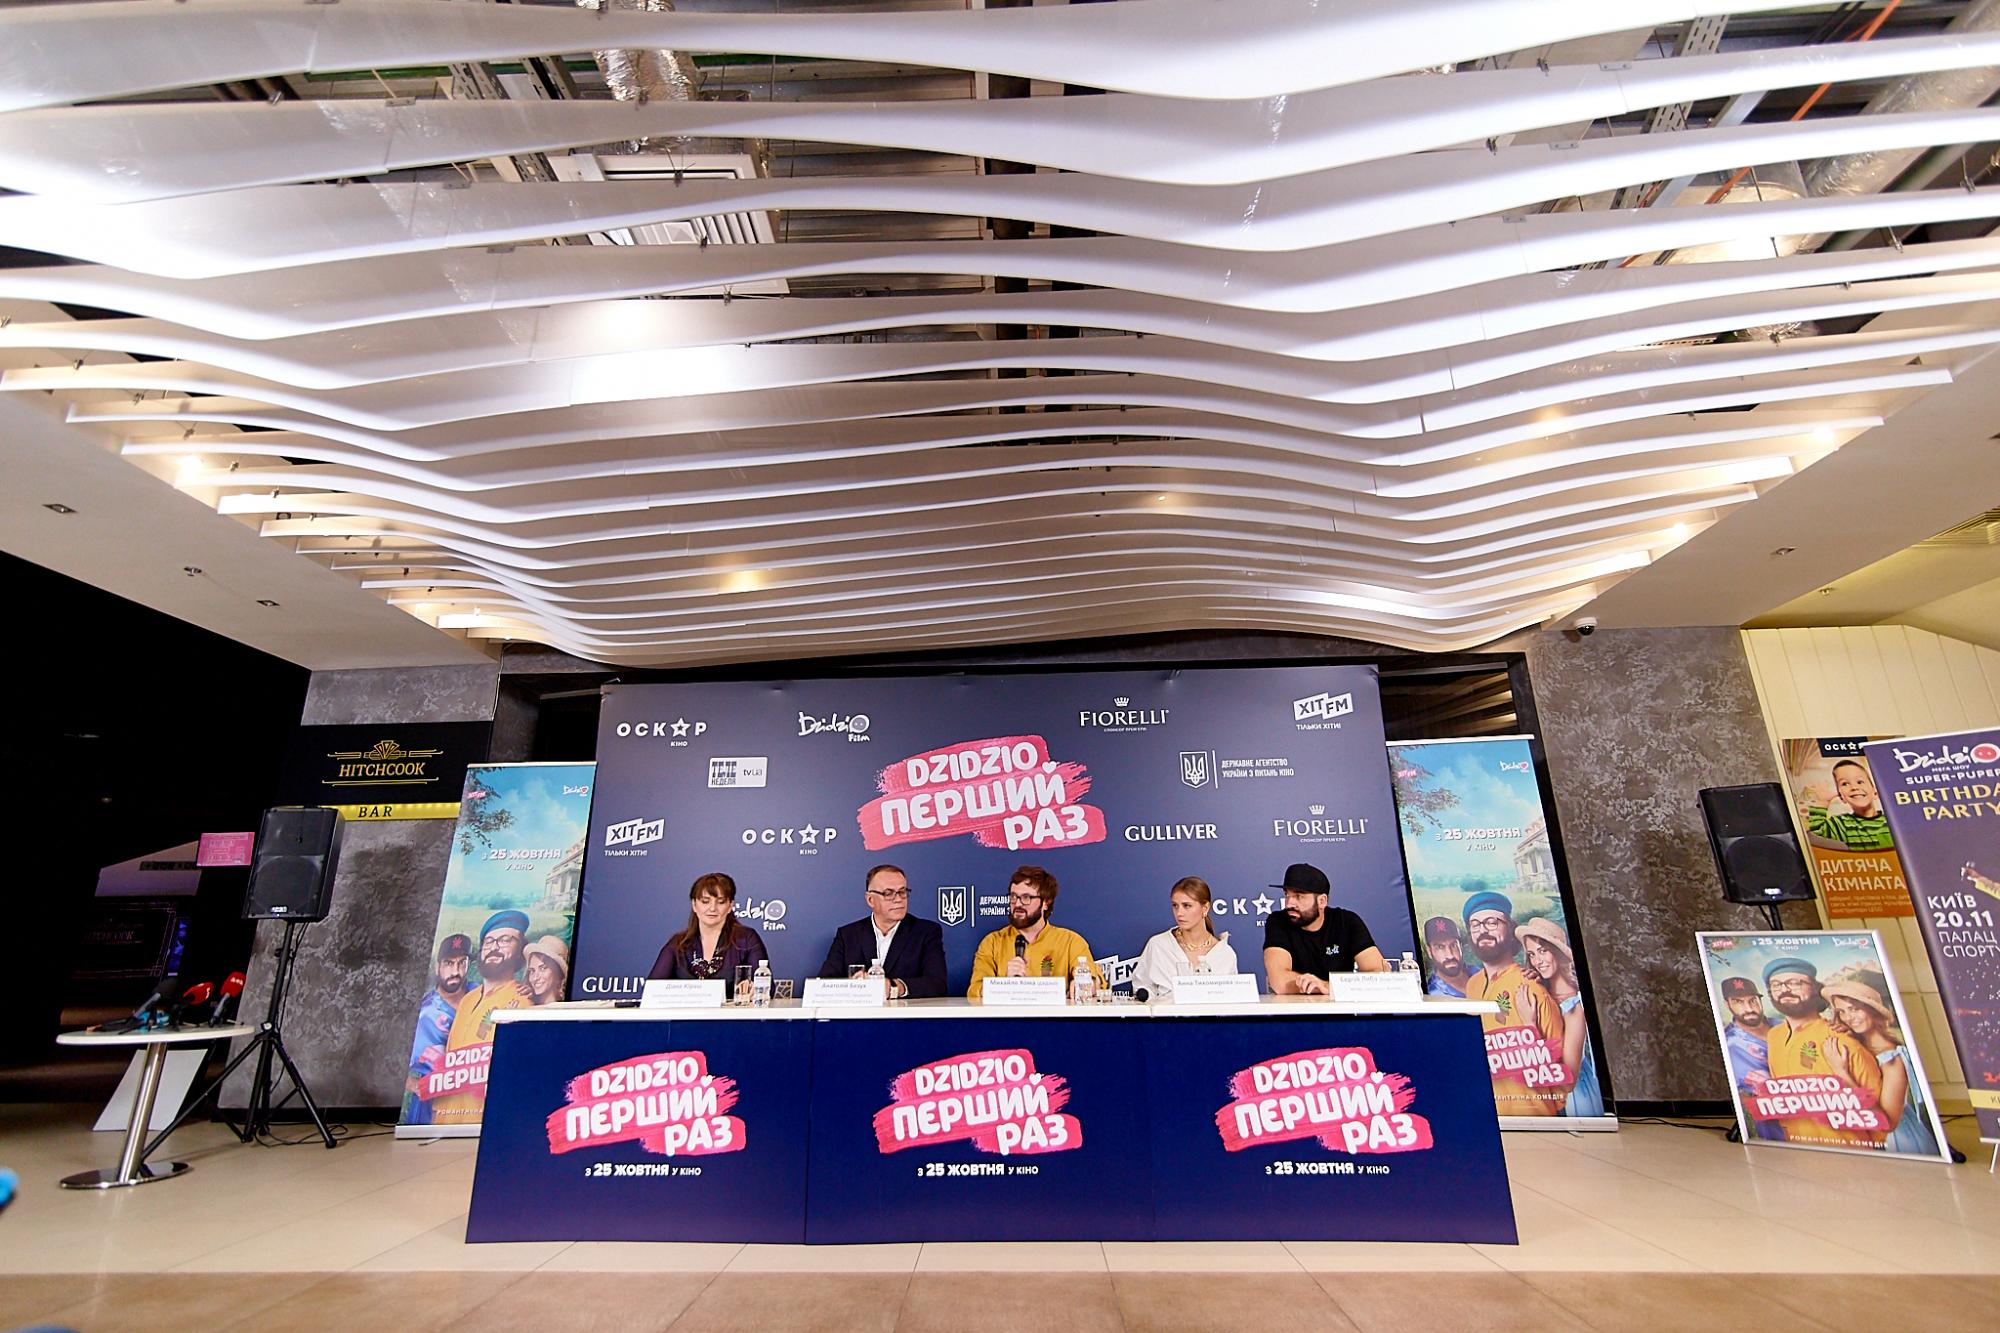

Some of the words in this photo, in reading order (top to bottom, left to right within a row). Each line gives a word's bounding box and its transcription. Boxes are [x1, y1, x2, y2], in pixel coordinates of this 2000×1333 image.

[1326, 698, 1349, 715] FM
[1080, 710, 1167, 727] FIORELLI
[848, 733, 870, 742] Film
[338, 762, 426, 777] HITCHCOOK
[907, 741, 1039, 787] DZIDZIO
[1279, 768, 1294, 776] КІНО
[880, 762, 1066, 836] ПЕРШИЙ
[358, 806, 392, 818] BAR
[1922, 801, 2000, 820] PARTY
[637, 824, 660, 840] FM
[1003, 806, 1089, 850] РАЗ
[1124, 824, 1218, 842] GULLIVER
[1274, 819, 1366, 836] FIORELLI
[1443, 828, 1463, 841] 25
[1466, 828, 1522, 840] ЖОВТНЯ
[490, 848, 507, 860] 25
[509, 848, 562, 860] ЖОВТНЯ
[1820, 858, 1893, 876] ДИТЯЧА
[1823, 876, 1906, 892] КІМНАТА
[1927, 892, 1977, 909] КИЇВ
[763, 921, 786, 930] Film
[1933, 910, 1994, 928] 20.11
[1758, 937, 1773, 946] 25
[1775, 937, 1820, 945] ЖОВТНЯ
[1938, 931, 1998, 945] ПАЛАЦ
[582, 976, 646, 993] GULLI
[1484, 1028, 1535, 1051] ZIDZIO
[445, 1045, 494, 1068] DZIDZ
[1487, 1039, 1552, 1074] РШИЙ
[429, 1064, 489, 1094] ПЕРШ
[590, 1056, 699, 1098] DZIDZIO
[915, 1054, 1027, 1096] DZIDZIO
[1252, 1052, 1367, 1094] DZIDZIO
[1523, 1063, 1565, 1088] РАЗ
[1765, 1077, 1841, 1094] DZIDZIO
[565, 1075, 717, 1142] ПЕРШИЙ
[892, 1072, 1049, 1141] ПЕРШИЙ
[1234, 1071, 1395, 1139] ПЕРШИЙ
[1756, 1088, 1861, 1116] ПЕРШИЙ
[1826, 1110, 1879, 1129] РАЗ
[664, 1116, 733, 1156] РАЗ
[996, 1114, 1069, 1156] РАЗ
[1341, 1113, 1418, 1155] РАЗ
[1789, 1135, 1847, 1145] РОМАНТИЧНА
[593, 1163, 612, 1176] 25
[614, 1163, 669, 1176] ЖОВТНЯ
[680, 1166, 702, 1176] КІНО
[926, 1163, 945, 1176] 25
[947, 1163, 1005, 1176] ЖОВТНЯ
[1016, 1165, 1039, 1175] КІНО
[1274, 1161, 1294, 1175] 25
[1296, 1161, 1354, 1175] ЖОВТНЯ
[1366, 1165, 1390, 1174] КІНО
